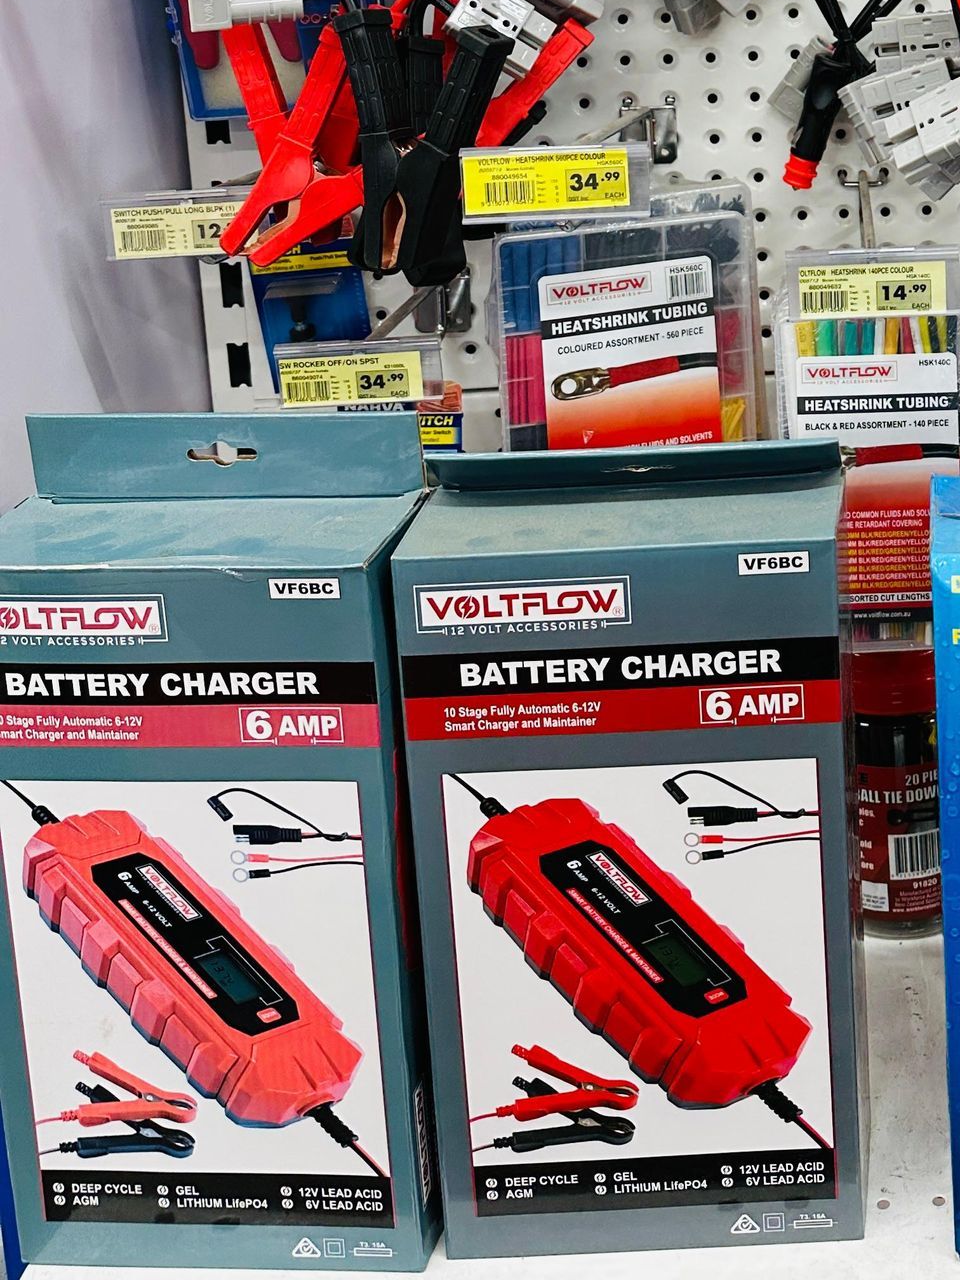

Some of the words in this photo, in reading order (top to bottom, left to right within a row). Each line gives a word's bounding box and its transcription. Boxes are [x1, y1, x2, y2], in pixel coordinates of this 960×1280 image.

[142, 208, 184, 216] PUSH/PULL
[552, 276, 646, 298] VOLTFLOW
[552, 312, 649, 336] HEATSHRINK
[652, 302, 708, 321] TUBING
[558, 342, 603, 355] COLOURED
[606, 332, 660, 350] ASSORTMENT
[666, 330, 679, 338] 560
[681, 326, 704, 336] PIECE
[294, 360, 324, 369] ROCKER
[327, 359, 357, 367] OFF/ON
[744, 557, 803, 570] VF6BC
[427, 589, 618, 620] VOLTFLOW
[881, 594, 895, 602] CUT
[896, 593, 930, 601] LENGTHS
[451, 626, 465, 635] 12
[469, 624, 501, 635] VOLT
[507, 620, 598, 633] ACCESSORIES
[460, 658, 610, 687] BATTERY
[621, 649, 782, 680] CHARGER
[444, 706, 455, 717] 10
[458, 706, 487, 718] Stage
[490, 705, 516, 717] Fully
[518, 702, 570, 715] Automatic
[572, 702, 601, 713] 6-12V
[706, 693, 732, 720] 6
[739, 693, 799, 716] AMP
[740, 1164, 760, 1175] 12V
[763, 1163, 794, 1173] LEAD
[797, 1162, 824, 1172] ACID
[505, 1177, 537, 1187] DEEP
[539, 1174, 578, 1185] CYCLE
[614, 1171, 637, 1181] GEL
[614, 1183, 661, 1193] LITHIUM
[664, 1180, 708, 1191] LifePO4
